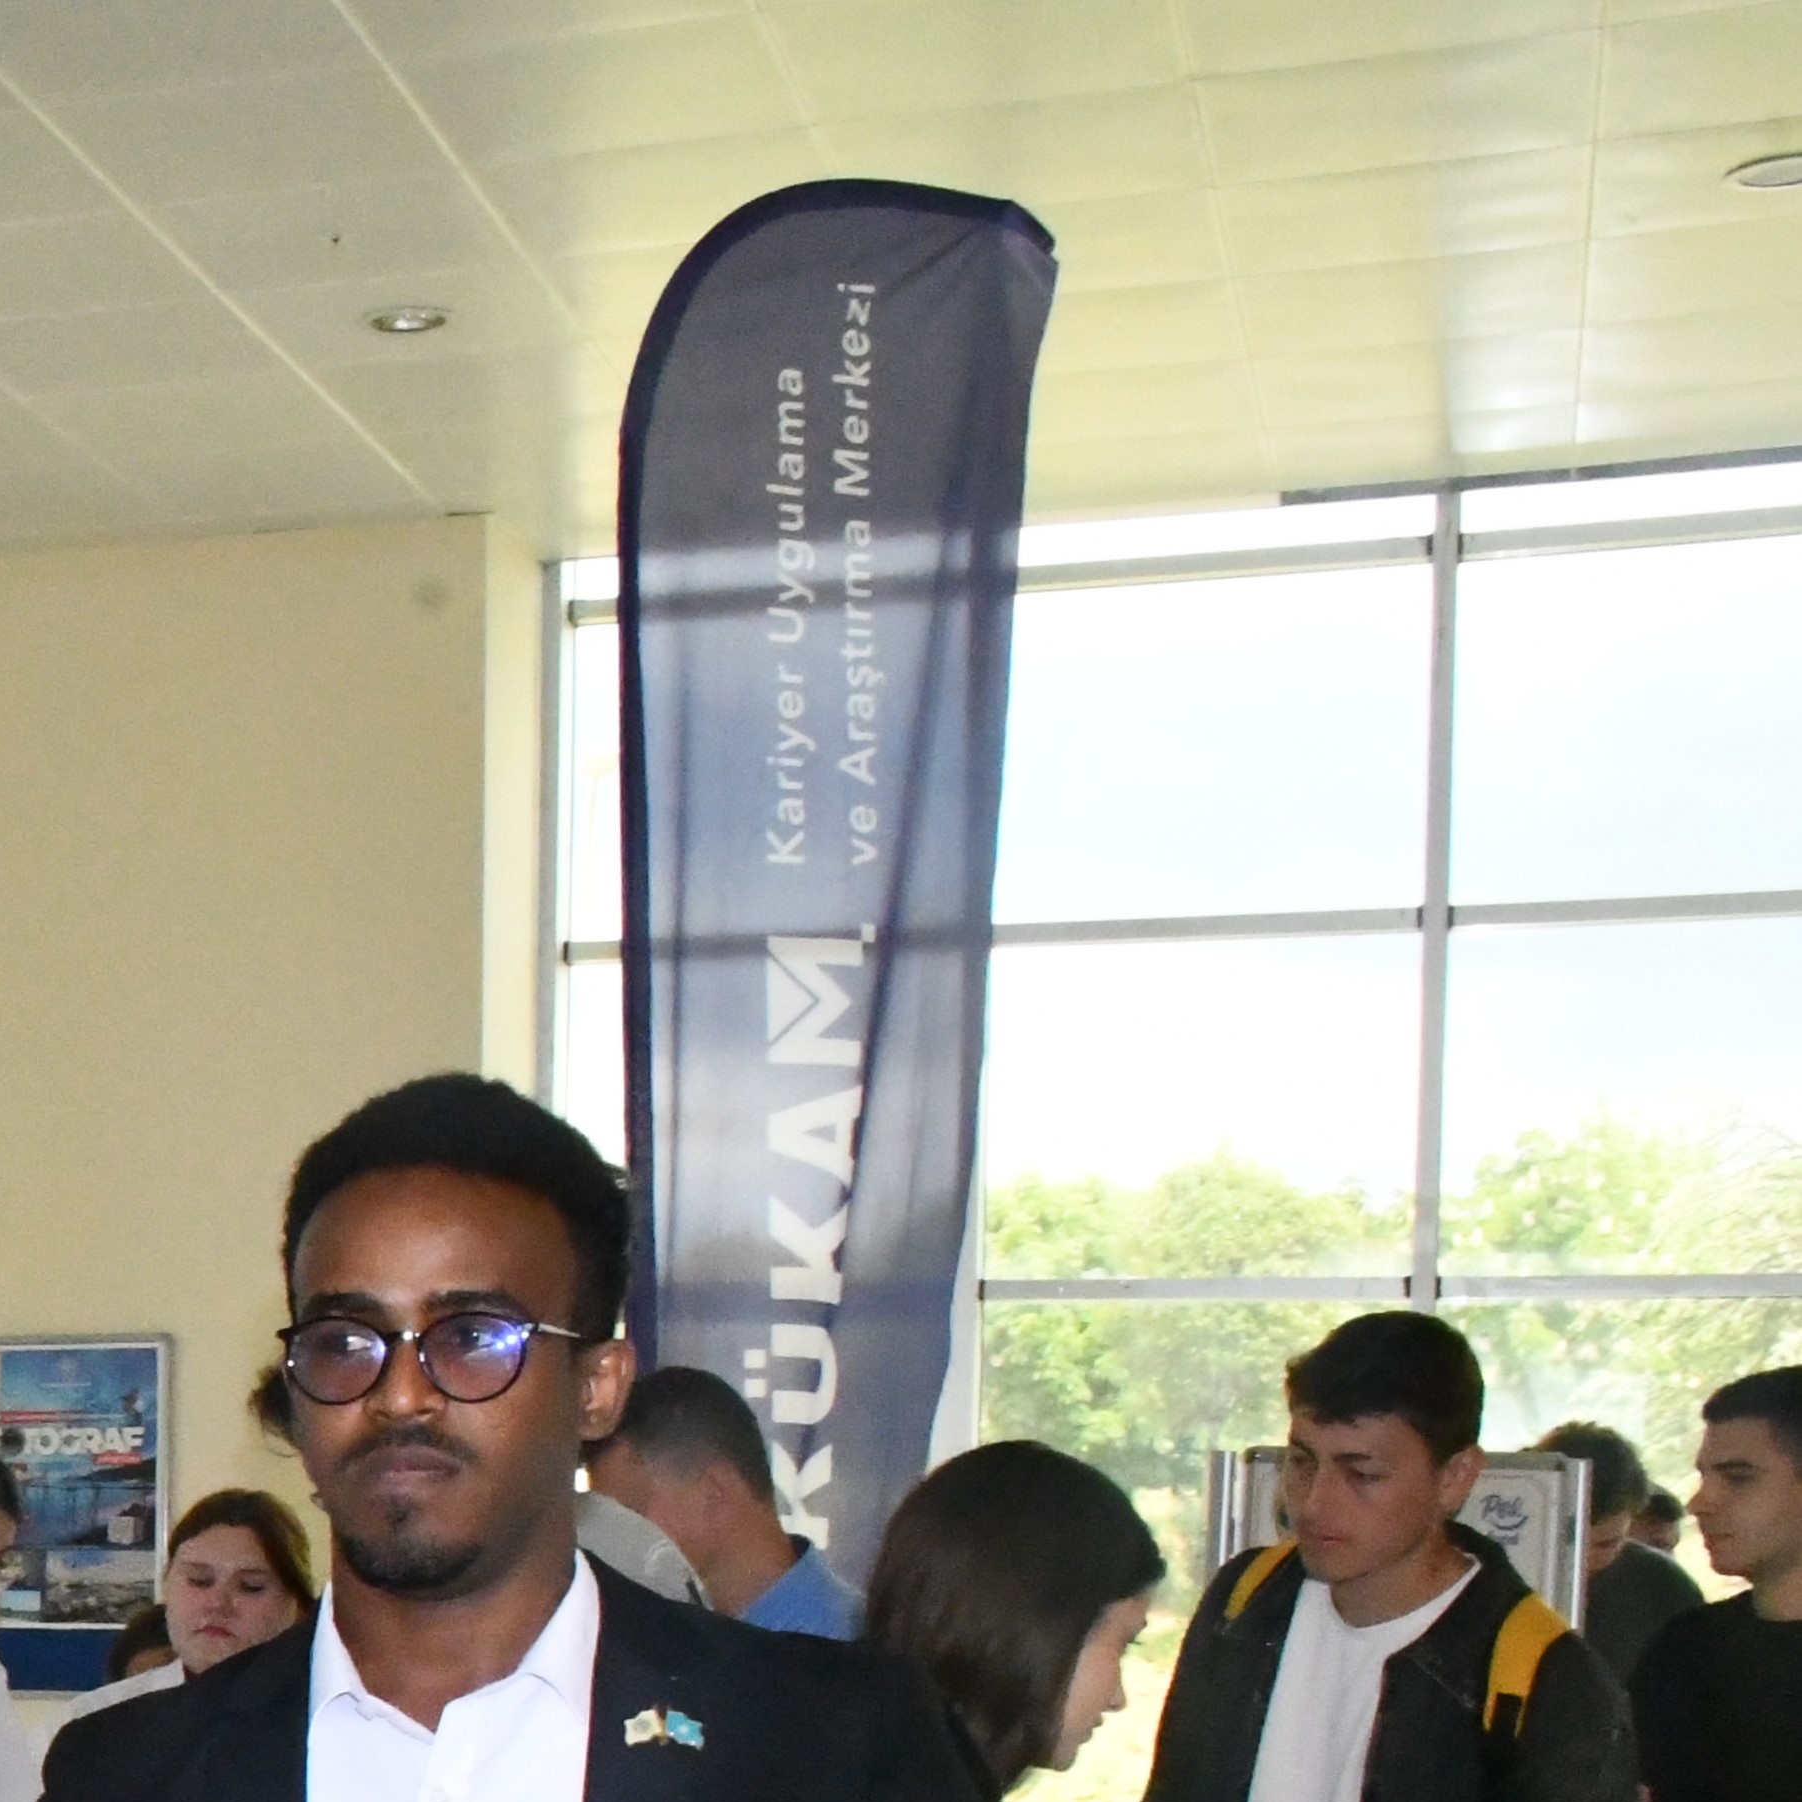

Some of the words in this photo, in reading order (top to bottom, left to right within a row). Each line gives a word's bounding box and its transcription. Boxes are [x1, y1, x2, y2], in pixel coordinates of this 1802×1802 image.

[832, 282, 876, 498] Merkezi
[765, 367, 816, 643] Uygulama
[837, 518, 886, 787] Araştırma
[765, 665, 816, 866] Kariyer
[850, 804, 878, 867] ve
